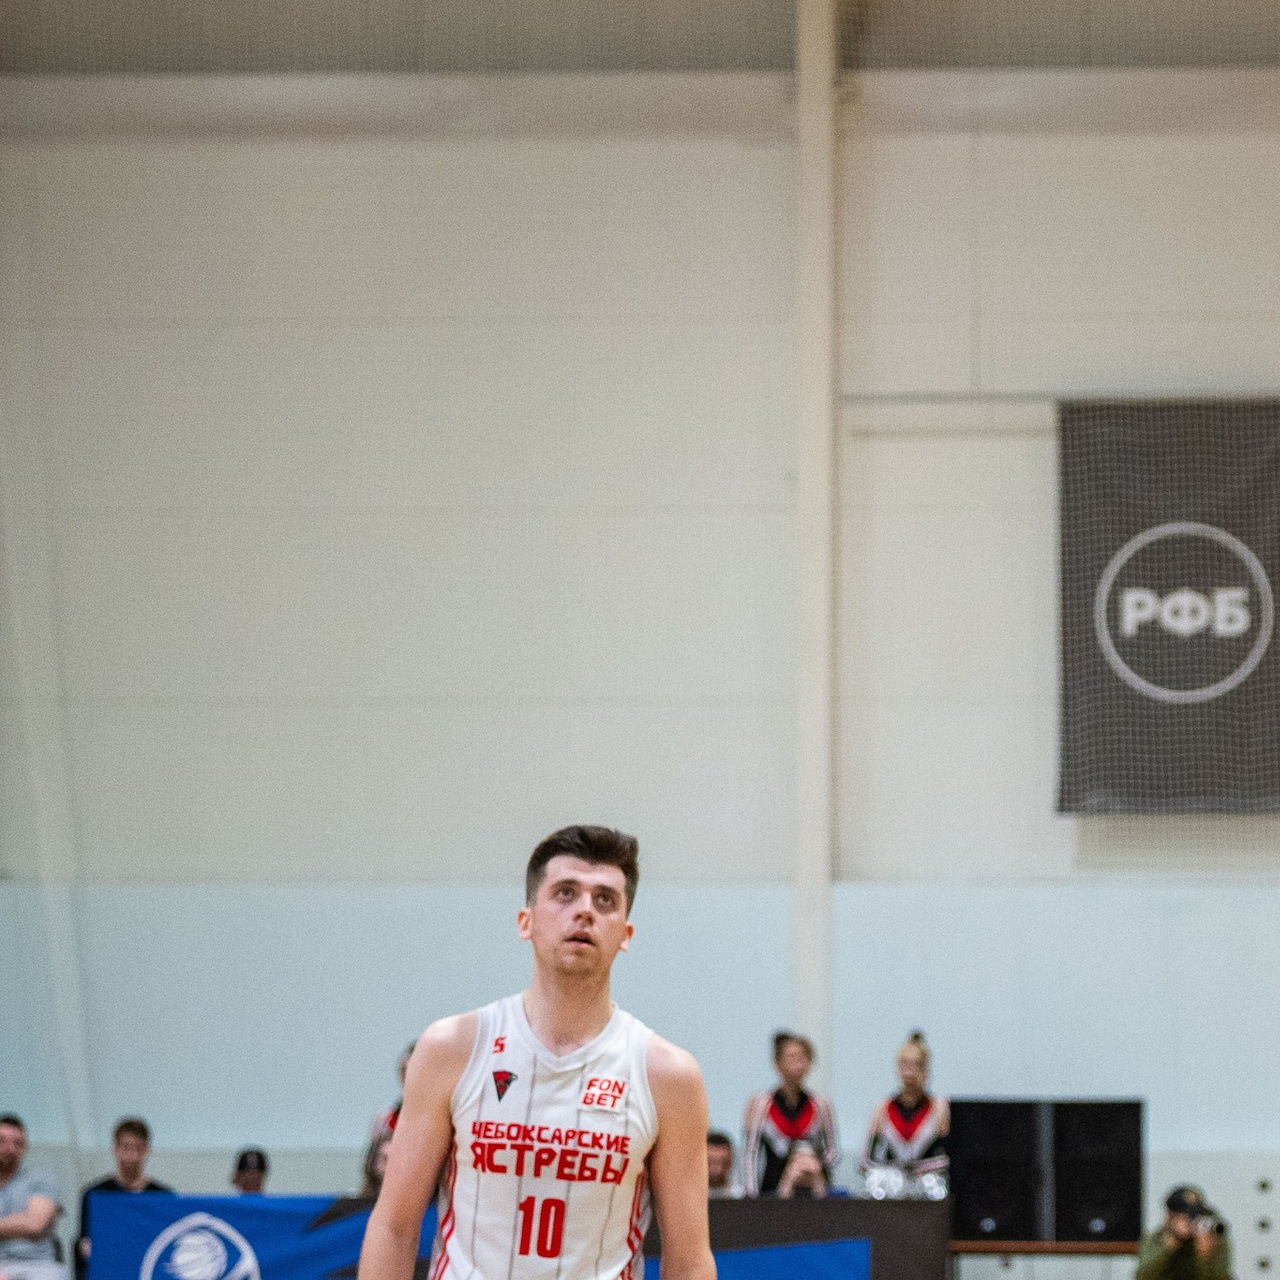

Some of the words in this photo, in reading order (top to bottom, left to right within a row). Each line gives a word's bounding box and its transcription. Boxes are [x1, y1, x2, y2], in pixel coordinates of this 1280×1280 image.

[1120, 587, 1251, 637] РФБ
[582, 1093, 621, 1108] BET
[587, 1078, 626, 1094] FON
[472, 1121, 630, 1154] ЧЕБОКСАРСКИЕ
[471, 1141, 629, 1185] ЯСТРЕБЫ
[518, 1195, 566, 1258] 10
